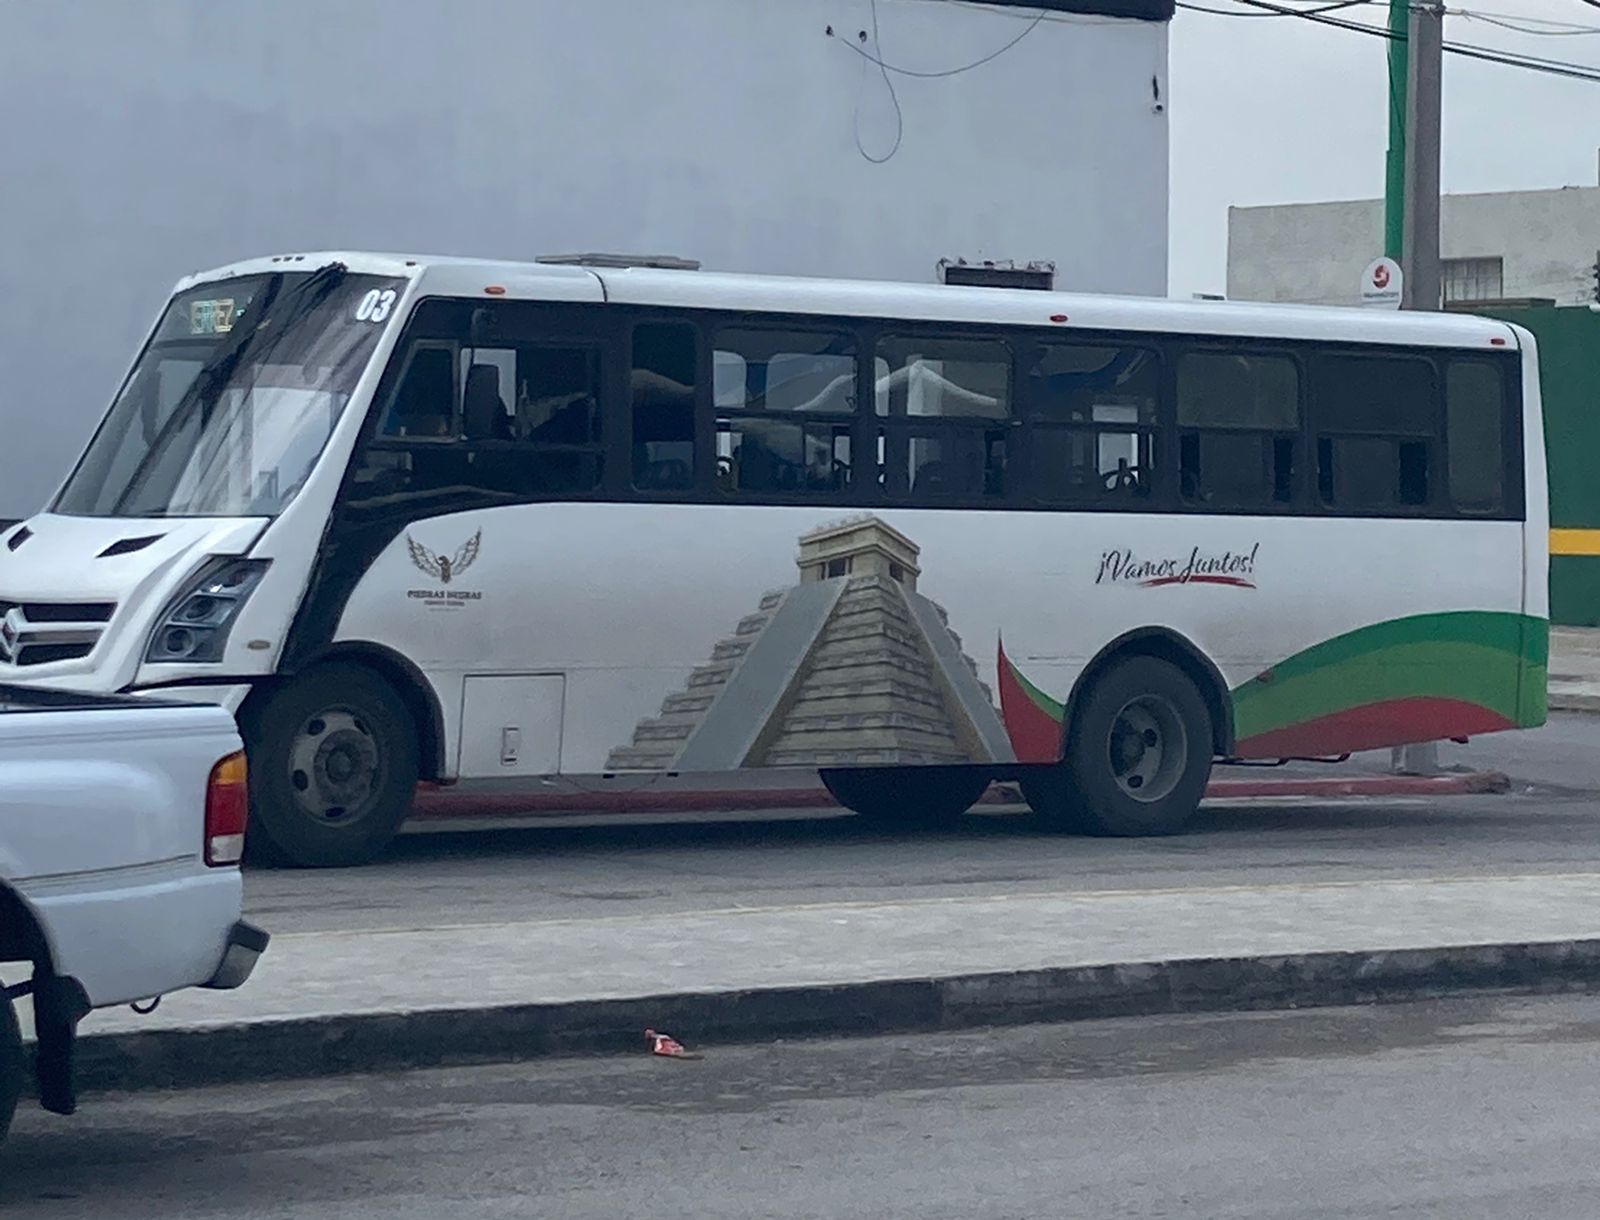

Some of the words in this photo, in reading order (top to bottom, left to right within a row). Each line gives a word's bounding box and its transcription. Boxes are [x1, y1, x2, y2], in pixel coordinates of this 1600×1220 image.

[356, 290, 397, 322] 03
[1095, 549, 1178, 584] ¡Vamos
[1180, 542, 1260, 584] Juntos!
